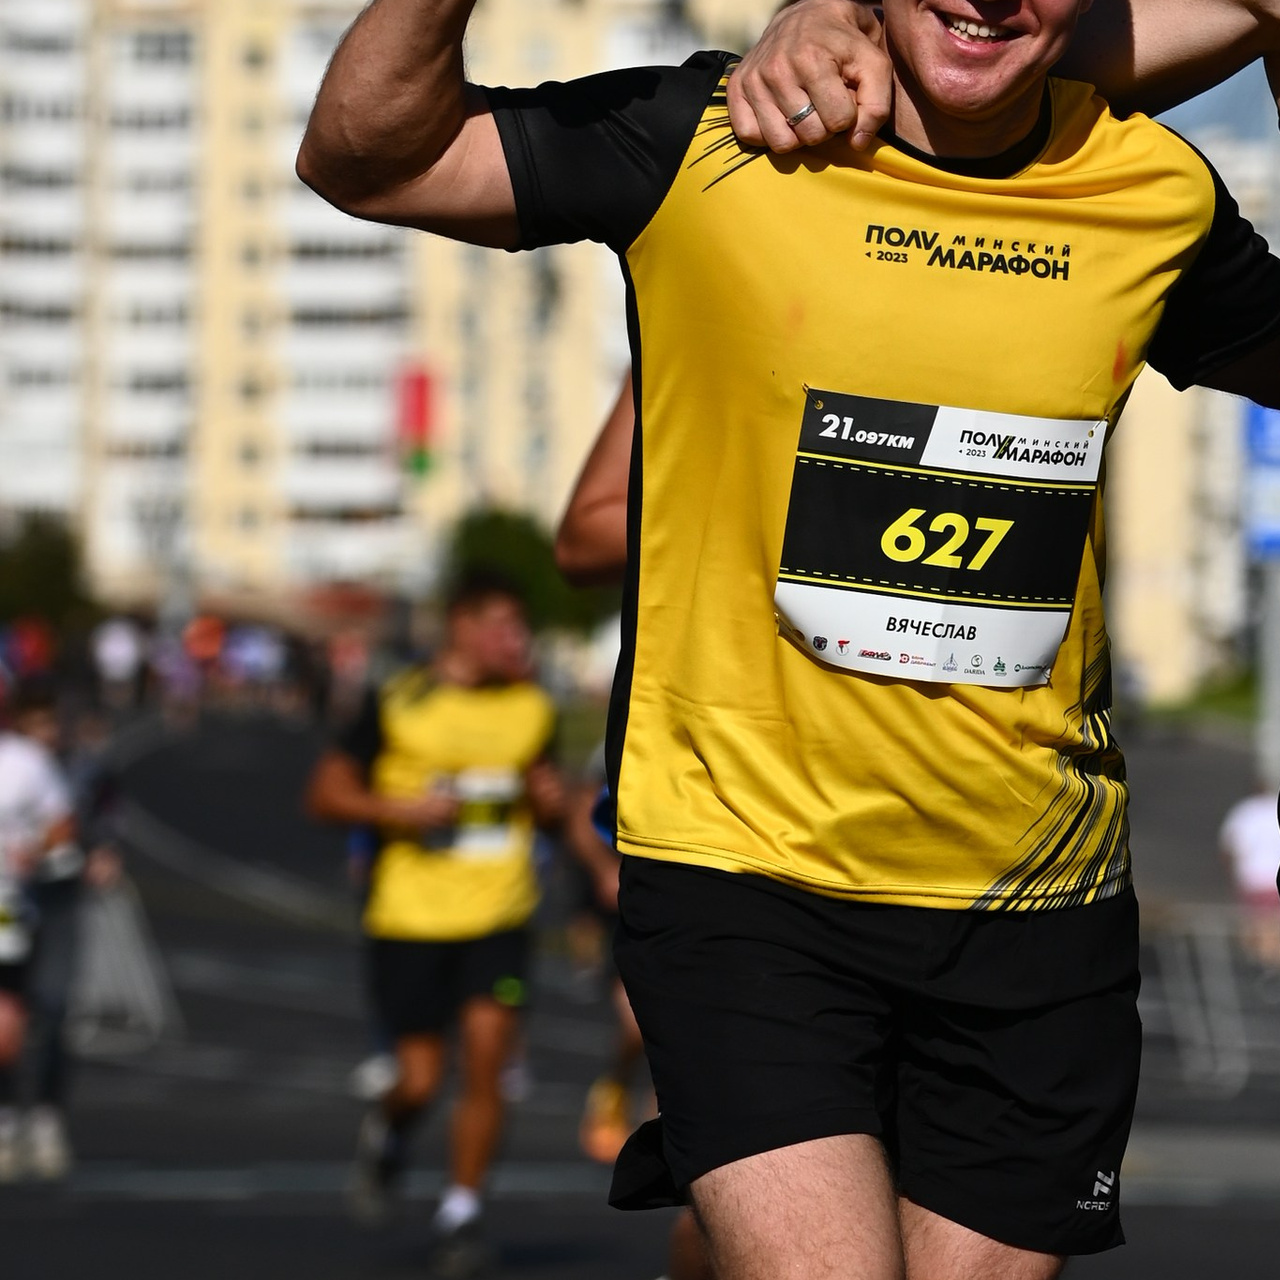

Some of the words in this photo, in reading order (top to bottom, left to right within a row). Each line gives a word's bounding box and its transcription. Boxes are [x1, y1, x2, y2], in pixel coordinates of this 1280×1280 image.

[952, 235, 1071, 257] МИНСКИЙ
[876, 251, 908, 263] 2023
[927, 245, 1070, 281] МАРАФОН
[965, 448, 987, 458] 2023
[1018, 437, 1089, 450] МИНСКИЙ
[999, 446, 1087, 466] МАРАФОН
[880, 508, 1015, 571] 627
[885, 617, 978, 641] ВЯЧЕСЛАВ
